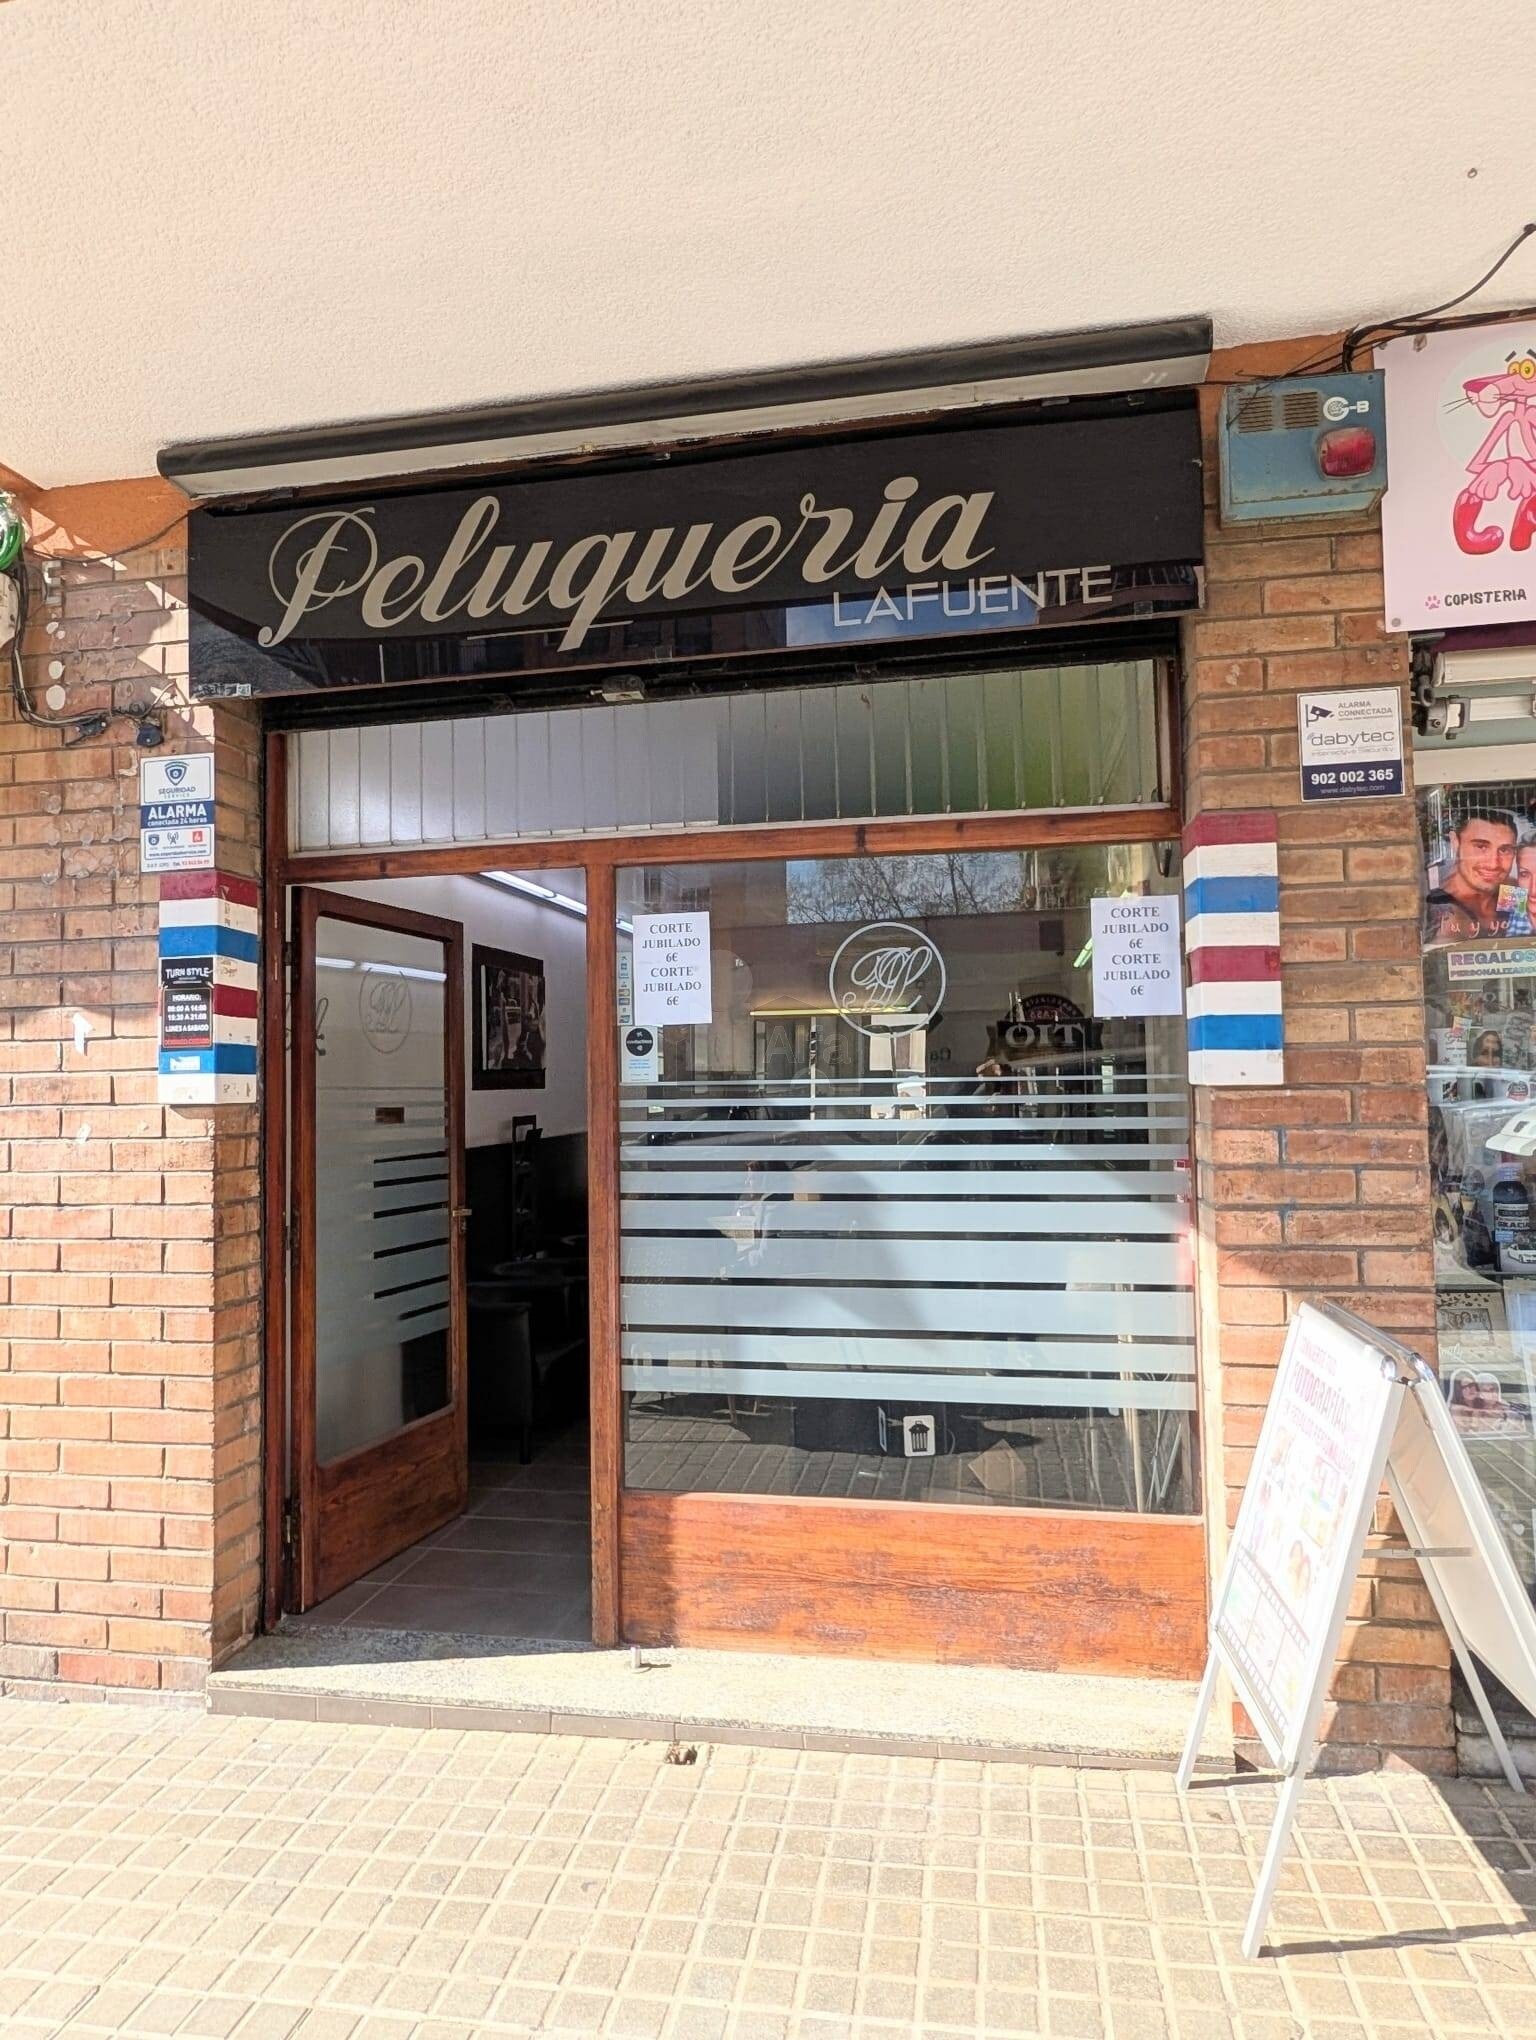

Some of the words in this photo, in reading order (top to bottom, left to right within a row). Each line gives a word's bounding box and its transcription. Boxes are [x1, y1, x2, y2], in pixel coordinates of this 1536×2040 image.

[258, 476, 995, 652] Peluqueria
[833, 564, 1113, 628] LAFUENTE
[1444, 588, 1527, 607] COPISTERIA
[1338, 700, 1372, 709] ALARMA
[1338, 707, 1393, 717] CONNECTADA
[1310, 730, 1395, 747] dabytec
[1311, 772, 1336, 785] 902
[1340, 770, 1365, 784] 002
[1368, 768, 1394, 781] 365
[158, 786, 196, 795] SEGURIDAD
[148, 803, 207, 820] ALARMA
[147, 819, 179, 827] conectada
[188, 816, 208, 824] horas
[1110, 906, 1160, 918] CORTE
[650, 922, 693, 935] CORTE
[1102, 922, 1169, 934] JUBILADO
[642, 937, 701, 949] JUBILADO
[1129, 938, 1143, 949] 6€
[665, 952, 678, 963] 6€
[1111, 953, 1161, 965] CORTE
[1451, 950, 1536, 966] REGALOS
[186, 967, 210, 977] STYLE
[650, 966, 694, 978] CORTE
[1103, 969, 1170, 981] JUBILADO
[643, 981, 702, 993] JUBILADO
[1130, 985, 1144, 995] 6€
[666, 996, 680, 1006] 6€
